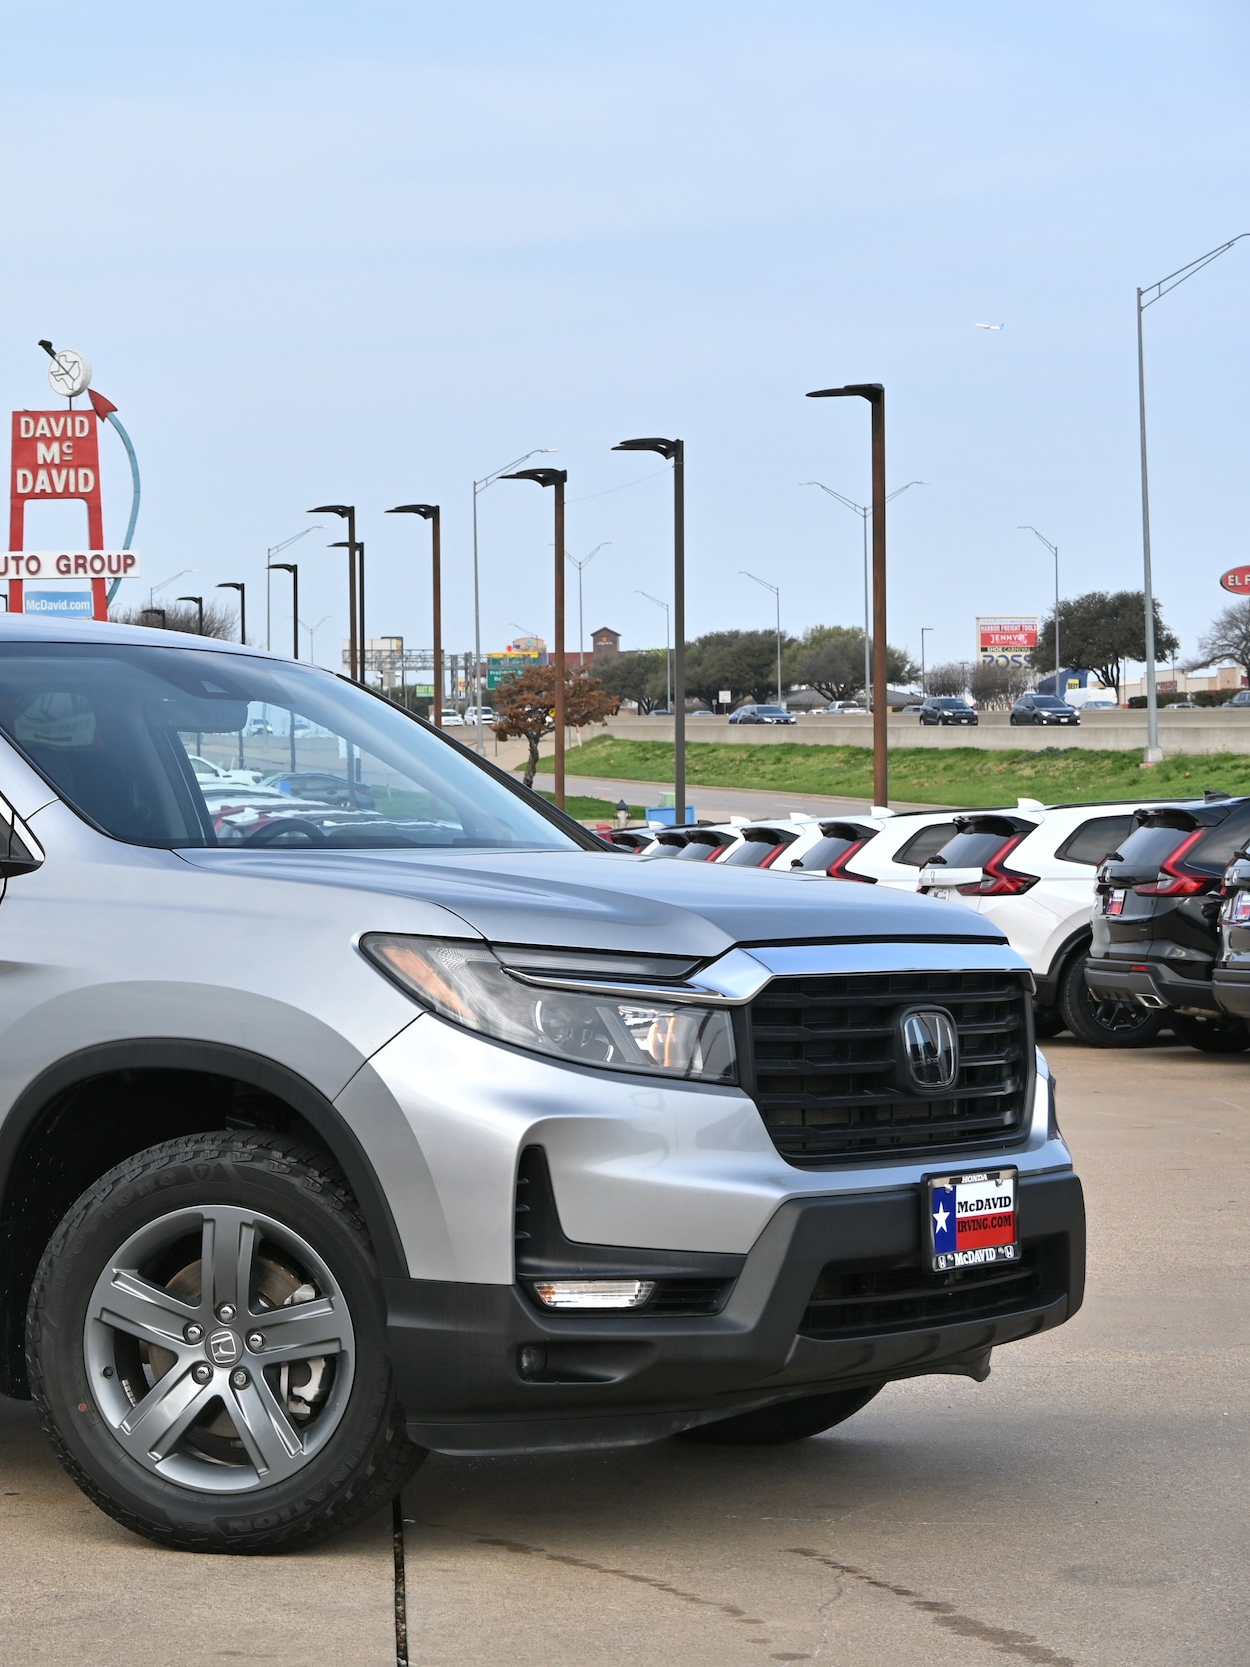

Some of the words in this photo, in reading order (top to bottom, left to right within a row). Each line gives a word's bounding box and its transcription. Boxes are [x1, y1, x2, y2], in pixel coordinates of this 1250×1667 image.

[20, 415, 90, 438] DAVID
[16, 467, 95, 494] DAVID
[56, 553, 136, 575] GROUP
[1227, 574, 1242, 586] EL
[26, 599, 90, 611] McDavid.com
[961, 1173, 988, 1184] HONDA
[957, 1196, 1012, 1213] McDAVID
[957, 1215, 1012, 1233] IRVING.COM
[954, 1247, 996, 1266] McDAVID
